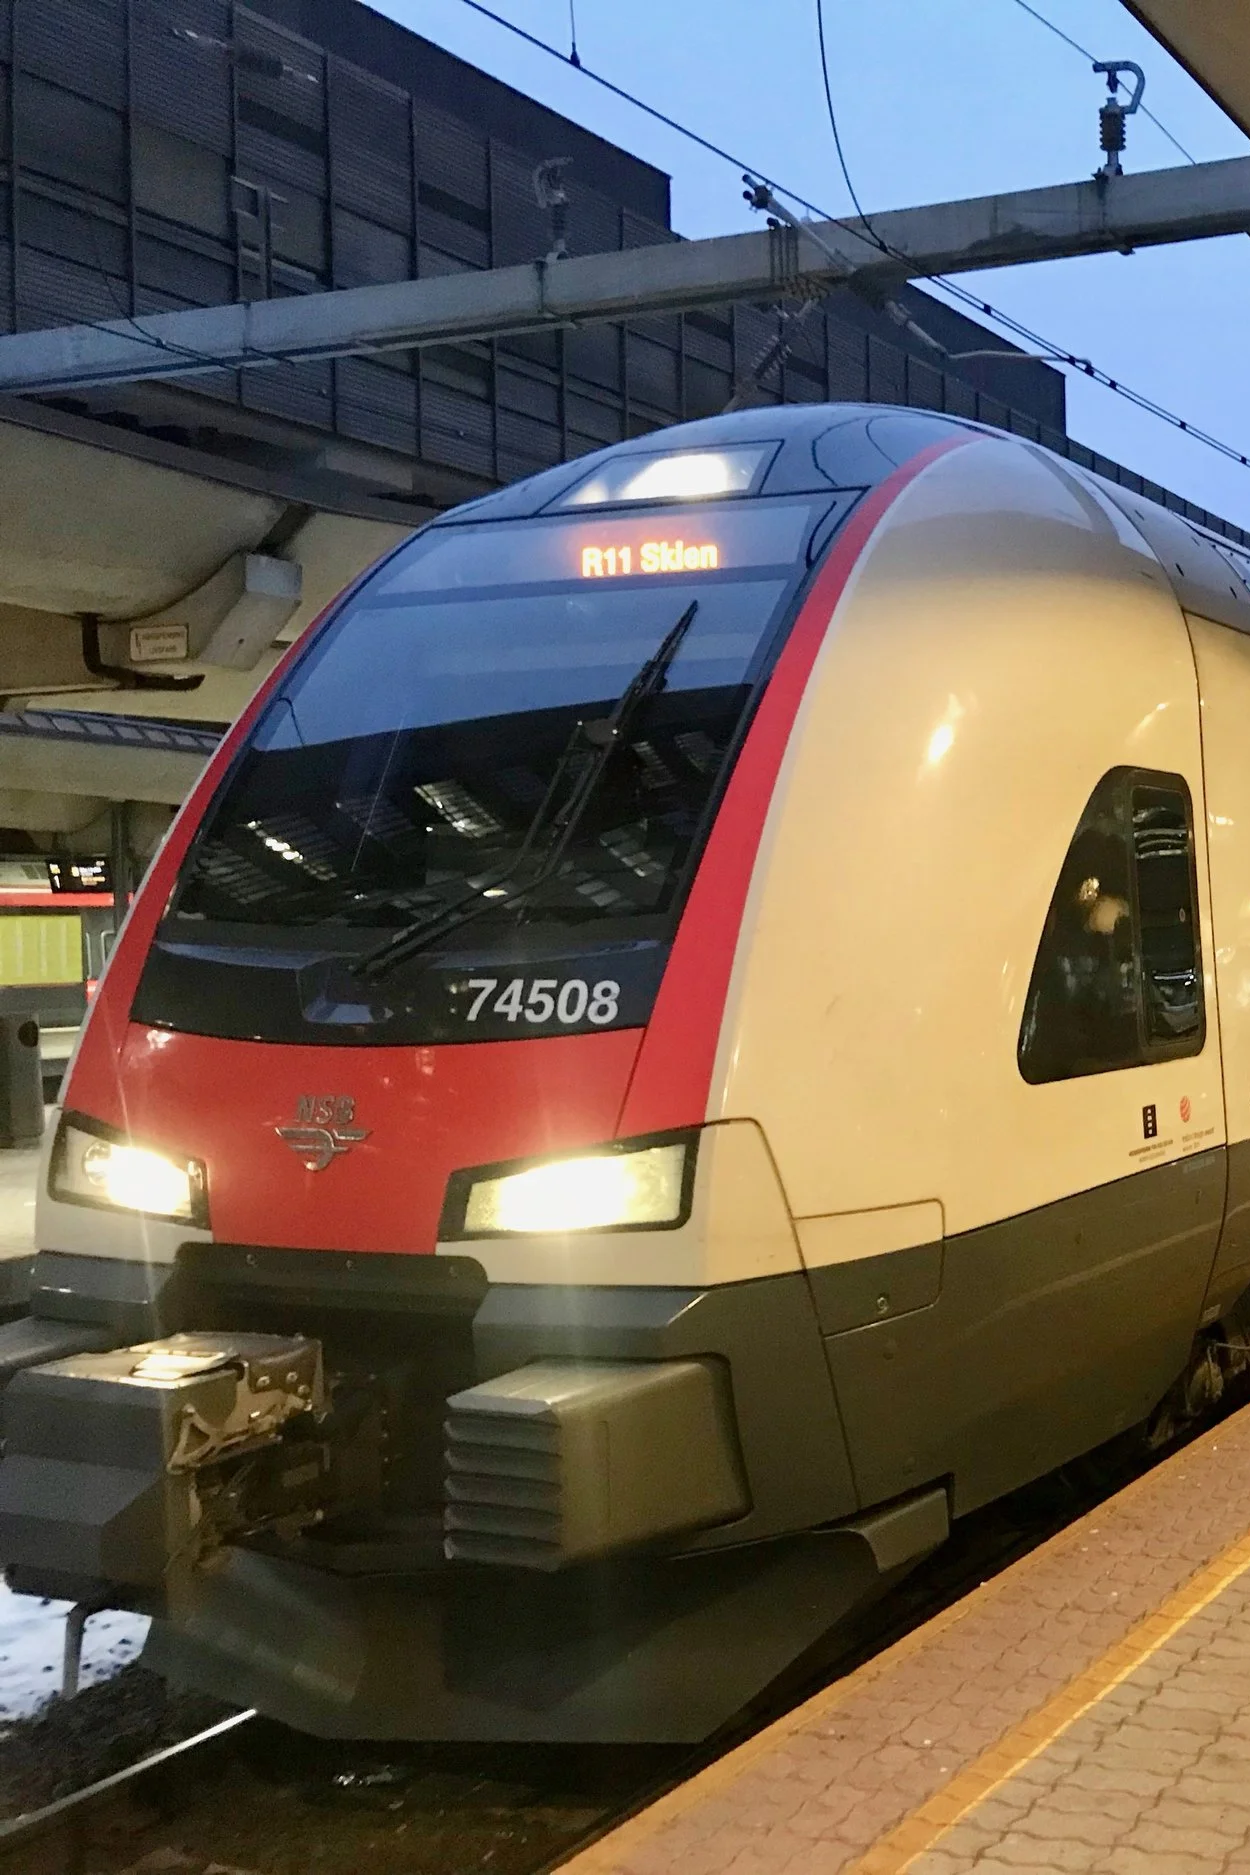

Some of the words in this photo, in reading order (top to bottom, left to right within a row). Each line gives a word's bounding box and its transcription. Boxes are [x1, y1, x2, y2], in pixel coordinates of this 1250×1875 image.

[581, 546, 631, 577] R11
[639, 539, 718, 573] Skien
[466, 978, 621, 1025] 74508
[297, 1095, 355, 1124] NSB
